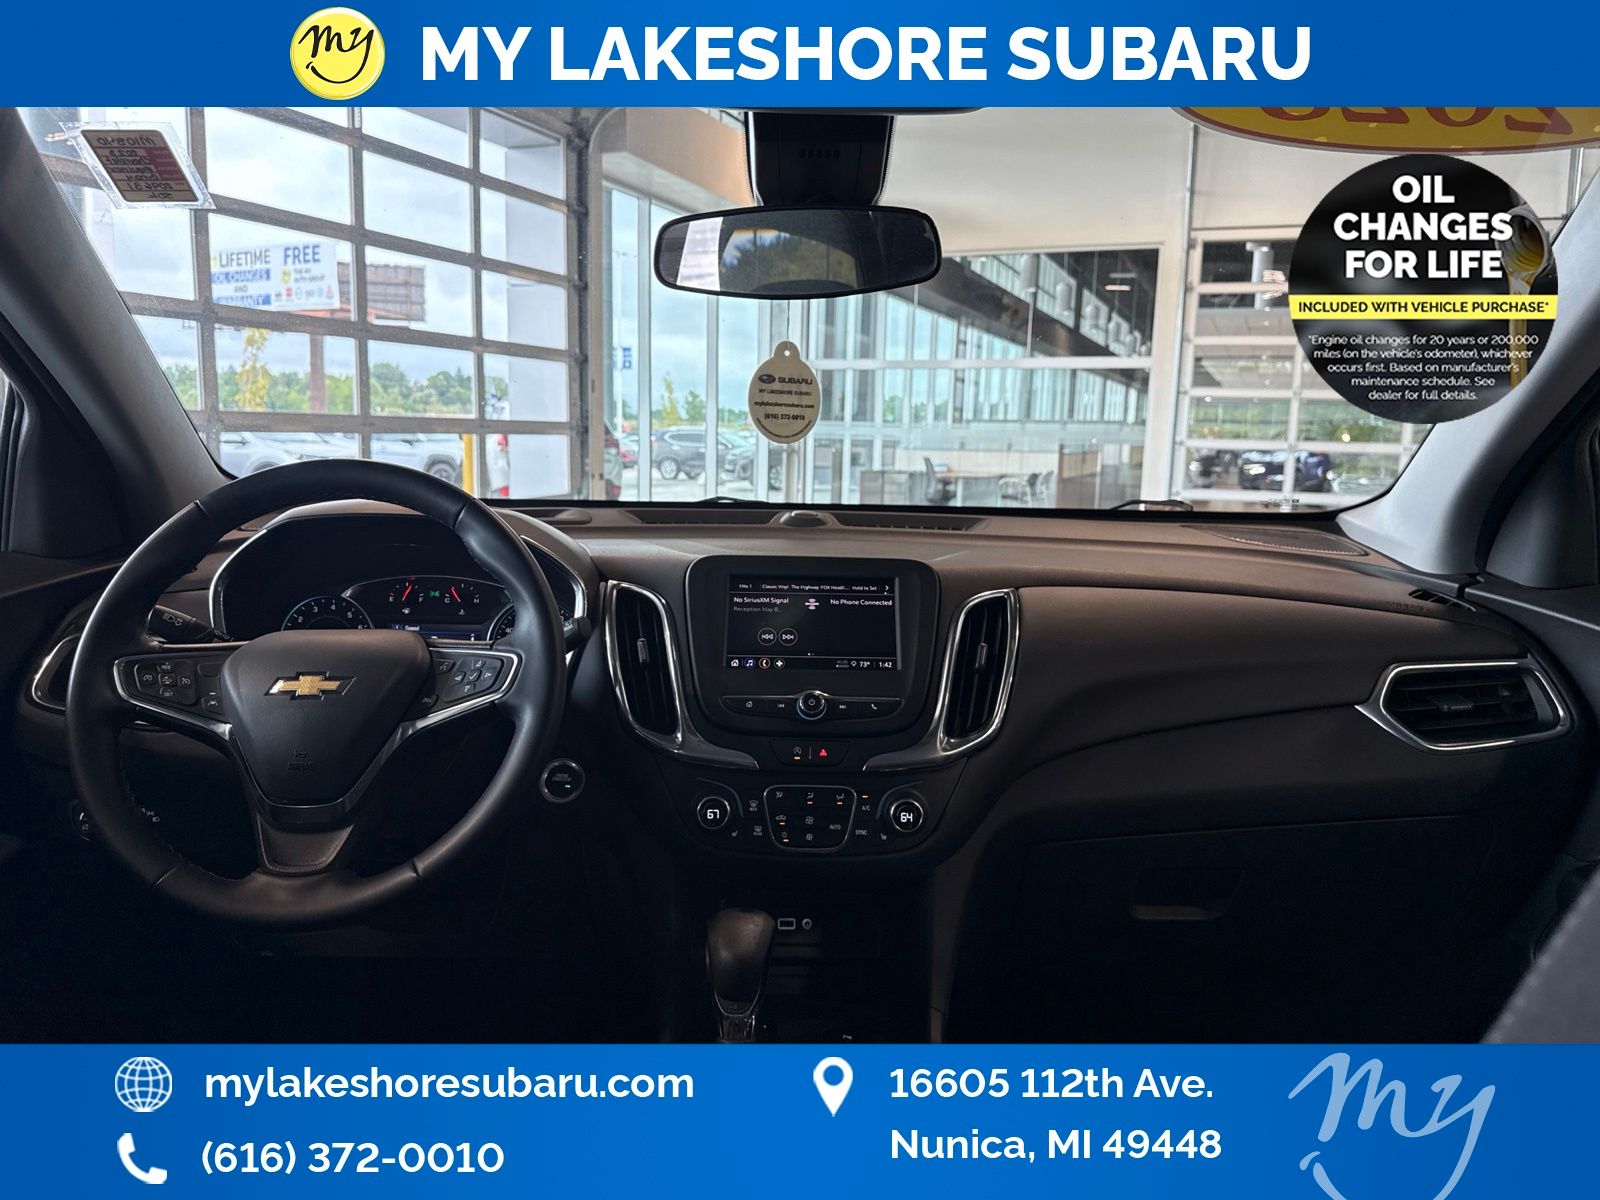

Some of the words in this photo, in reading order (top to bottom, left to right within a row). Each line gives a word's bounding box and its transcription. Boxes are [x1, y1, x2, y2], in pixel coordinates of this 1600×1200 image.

[219, 248, 272, 268] LIFETIME
[283, 244, 321, 266] FREE
[777, 376, 813, 385] SUBARU
[764, 412, 779, 421] (616)
[800, 584, 820, 592] Highway
[733, 596, 743, 604] No
[743, 596, 770, 604] SiriusXM
[770, 597, 789, 606] Signal
[830, 598, 840, 606] No
[840, 598, 858, 606] Phone
[859, 599, 893, 607] Connected
[733, 605, 761, 614] Reception
[761, 606, 774, 614] May
[861, 804, 871, 812] A/C
[706, 809, 720, 820] 67
[900, 811, 913, 823] 64
[855, 829, 868, 837] SYNC
